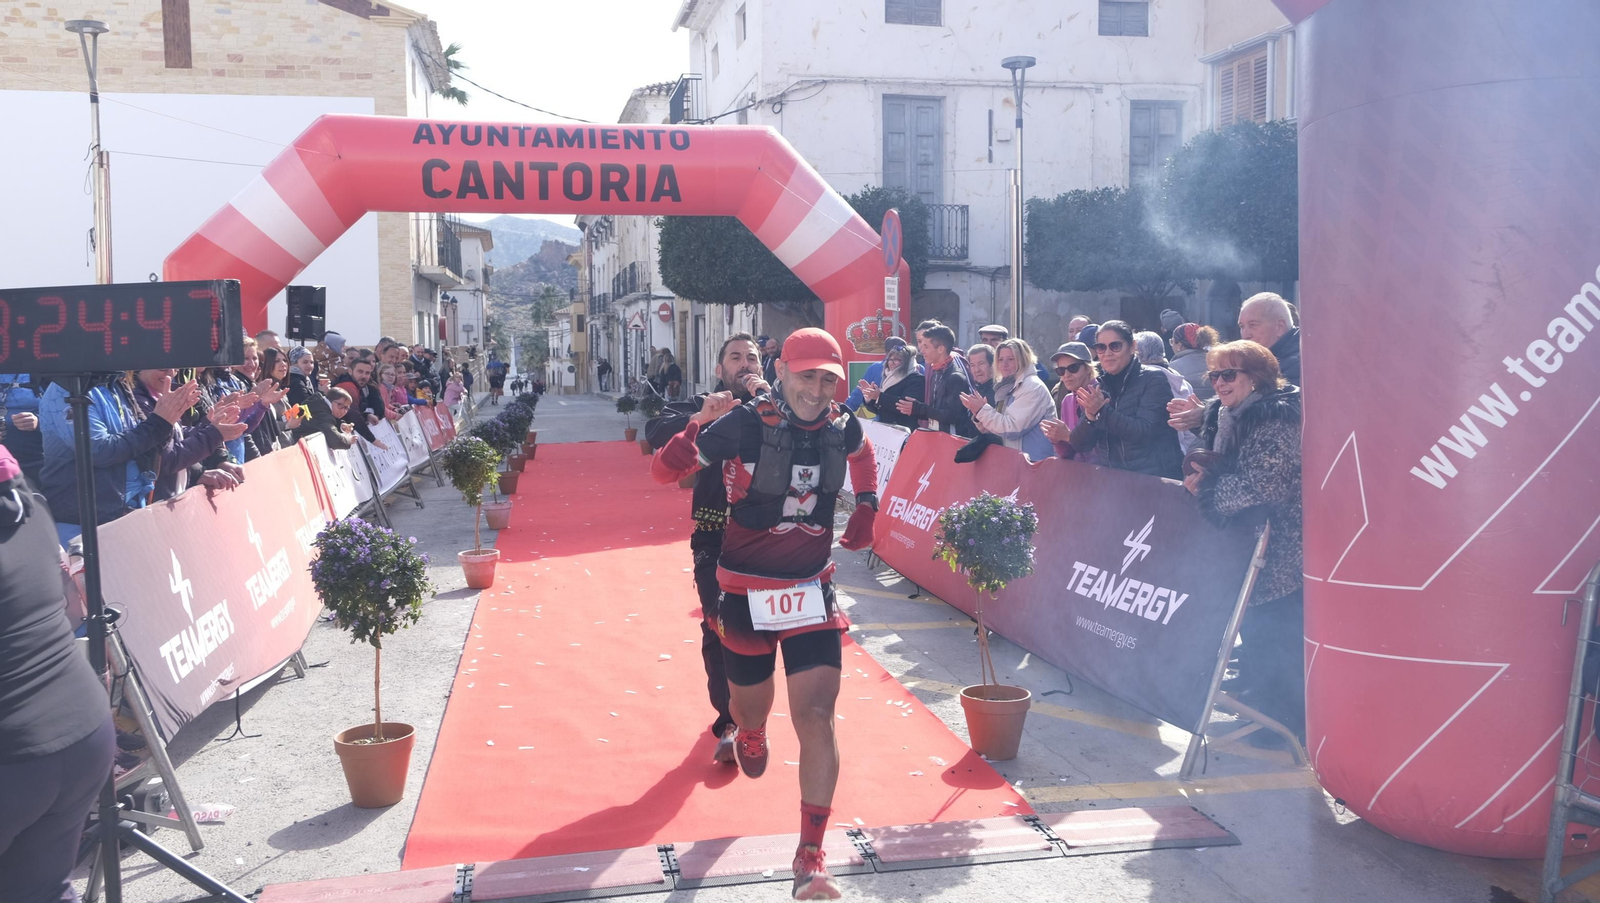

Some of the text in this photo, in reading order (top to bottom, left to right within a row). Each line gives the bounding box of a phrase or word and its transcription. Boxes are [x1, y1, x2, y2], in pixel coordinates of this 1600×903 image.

[412, 123, 690, 151] AYUNTAMIENTO
[421, 158, 682, 203] CANTORIA
[1409, 262, 1600, 490] www.team
[886, 495, 940, 532] TEAMERGY
[245, 546, 293, 612] TEAMERGY
[1066, 560, 1190, 626] TEAMERGY
[765, 591, 806, 616] 107
[159, 598, 235, 685] TEAMERGY
[1075, 614, 1138, 650] www.teamergy.es
